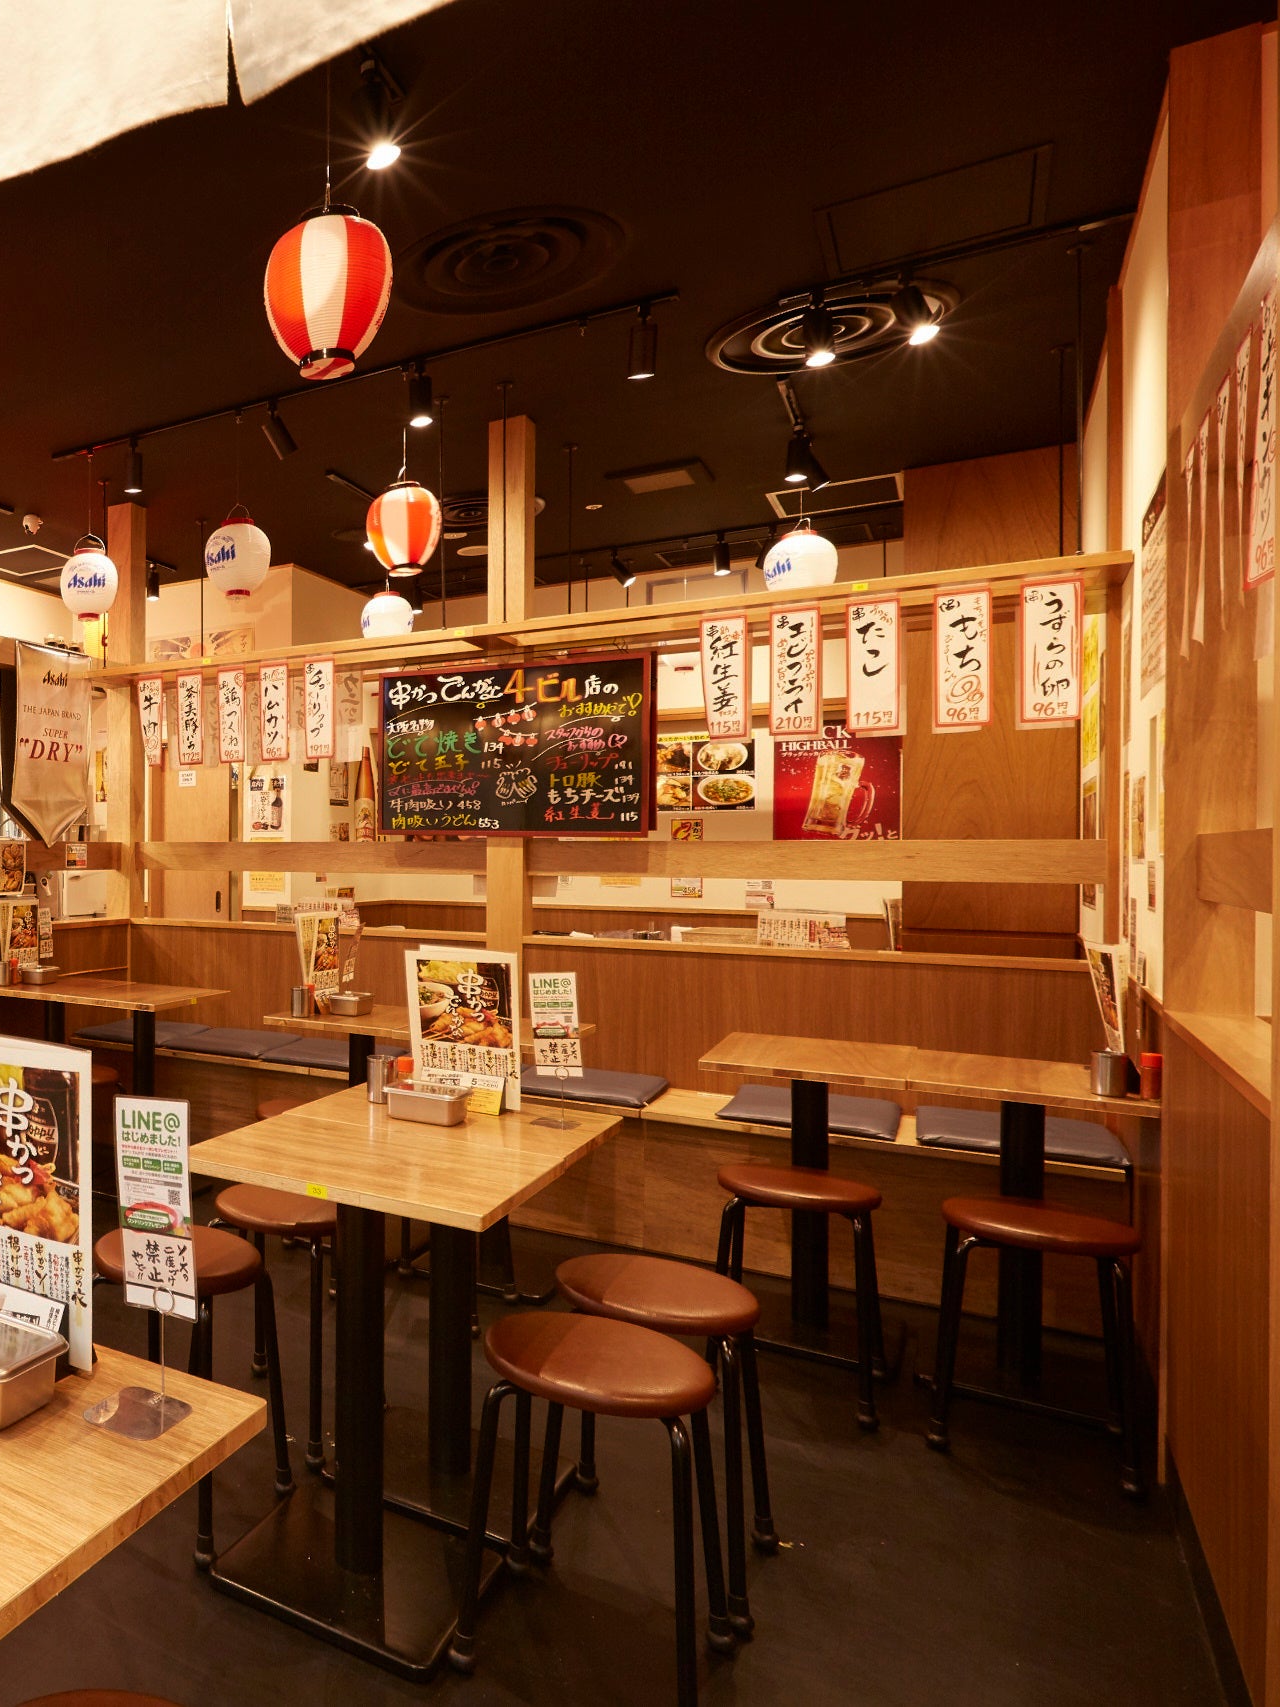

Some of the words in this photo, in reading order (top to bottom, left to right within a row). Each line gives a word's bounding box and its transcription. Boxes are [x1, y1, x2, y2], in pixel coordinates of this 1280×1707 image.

[67, 571, 107, 590] Asahi
[856, 621, 889, 678] たこ
[948, 615, 982, 672] もち
[1039, 591, 1071, 699] うずらの卵
[42, 668, 69, 689] Asahi
[710, 639, 740, 713] 紅生姜
[23, 704, 35, 714] THE
[38, 706, 59, 717] JAPAN
[61, 710, 82, 721] BRAND
[143, 694, 159, 736] 牛肉
[264, 684, 279, 744] ハムカツ
[853, 710, 894, 726] 115円
[946, 707, 980, 721] 96円
[1032, 701, 1069, 717] 96円
[709, 720, 741, 734] 115円
[775, 716, 813, 730] 210円
[42, 727, 69, 739] SUPER
[387, 731, 482, 759] どて焼き
[483, 741, 505, 755] 134
[780, 740, 853, 752] HIGHBALL
[480, 758, 501, 770] 115
[549, 771, 604, 788] トロ豚
[457, 799, 481, 811] 458
[547, 786, 625, 805] もちチーズ
[478, 817, 500, 829] 553
[620, 811, 639, 822] 115
[532, 978, 572, 989] LINE@
[455, 968, 488, 1023] 串かつ
[549, 1041, 560, 1064] 禁止
[121, 1108, 181, 1133] LINE@
[121, 1130, 181, 1147] はじめました!
[7, 1233, 23, 1278] 揚げ油
[140, 1239, 165, 1284] 禁止
[172, 1244, 189, 1283] ソースの
